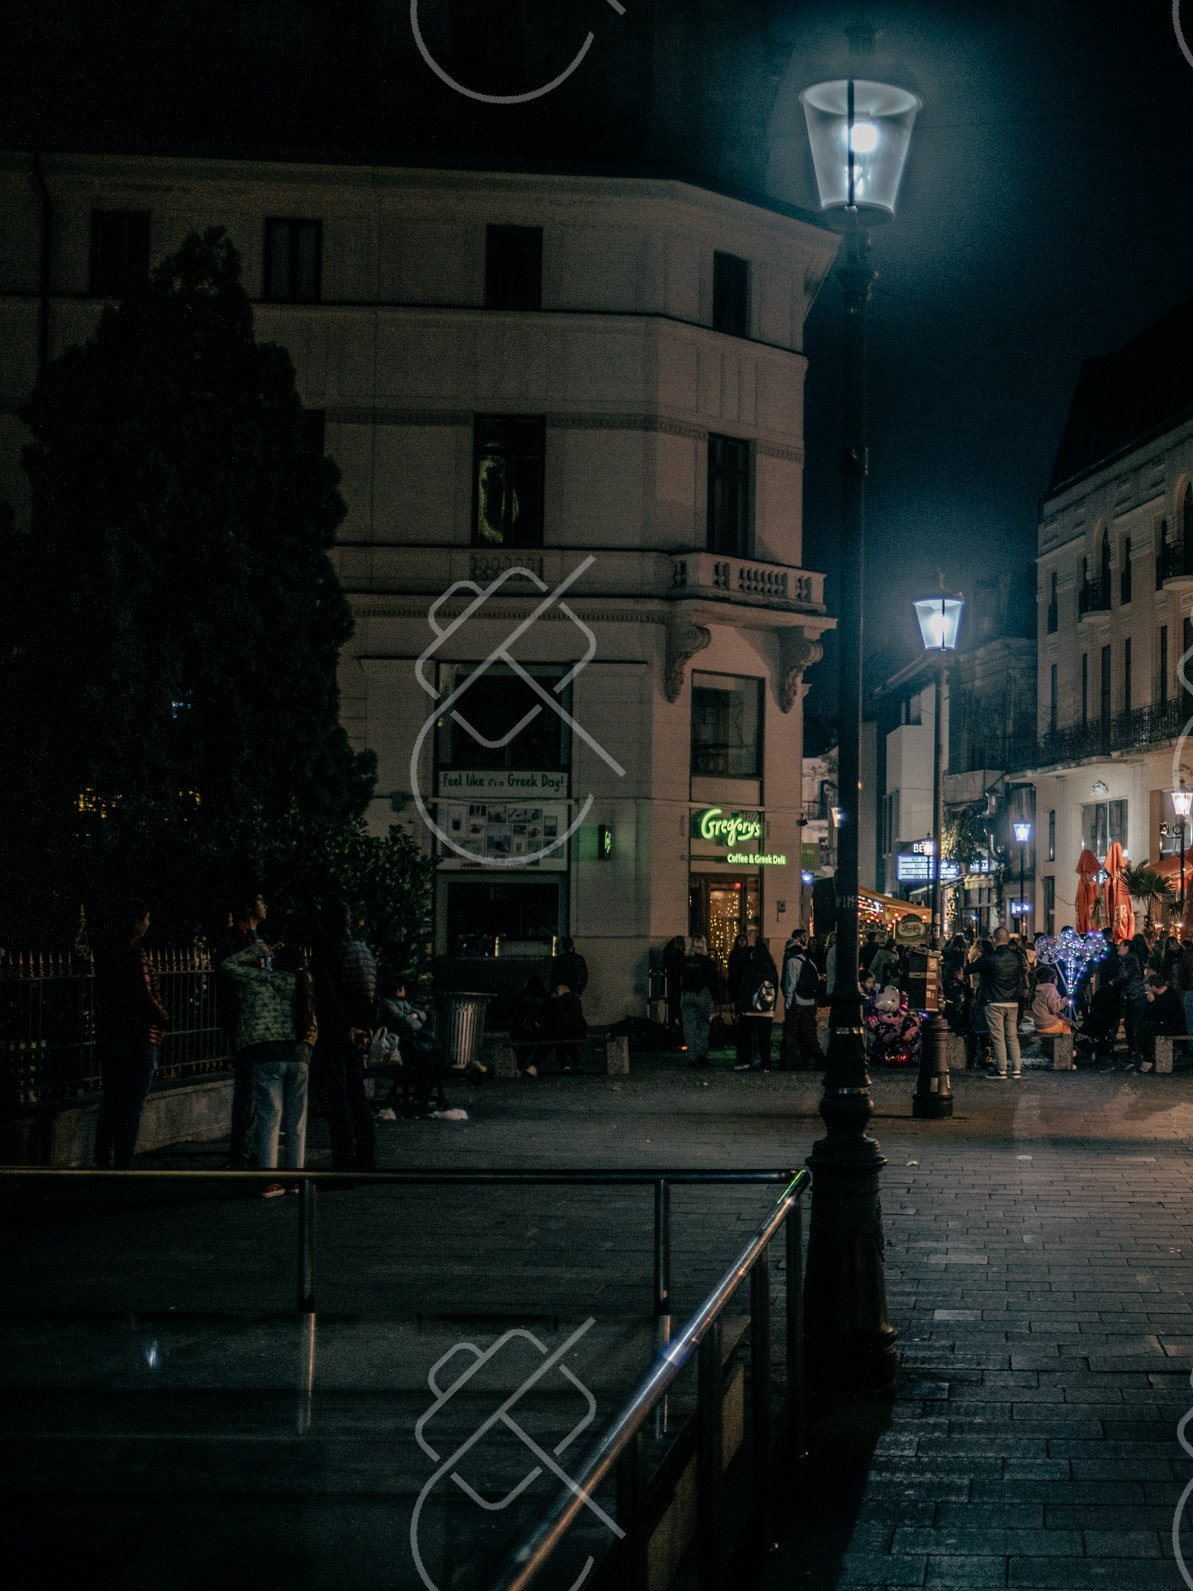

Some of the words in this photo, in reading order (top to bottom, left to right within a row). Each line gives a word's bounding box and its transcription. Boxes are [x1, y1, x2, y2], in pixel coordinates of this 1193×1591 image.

[443, 773, 463, 787] Feel
[466, 773, 486, 787] like
[507, 773, 538, 787] Greek
[541, 774, 564, 792] Day!
[701, 808, 761, 847] Gregory's
[727, 853, 749, 864] Coffee
[755, 854, 772, 864] Greek
[773, 855, 786, 865] Deli
